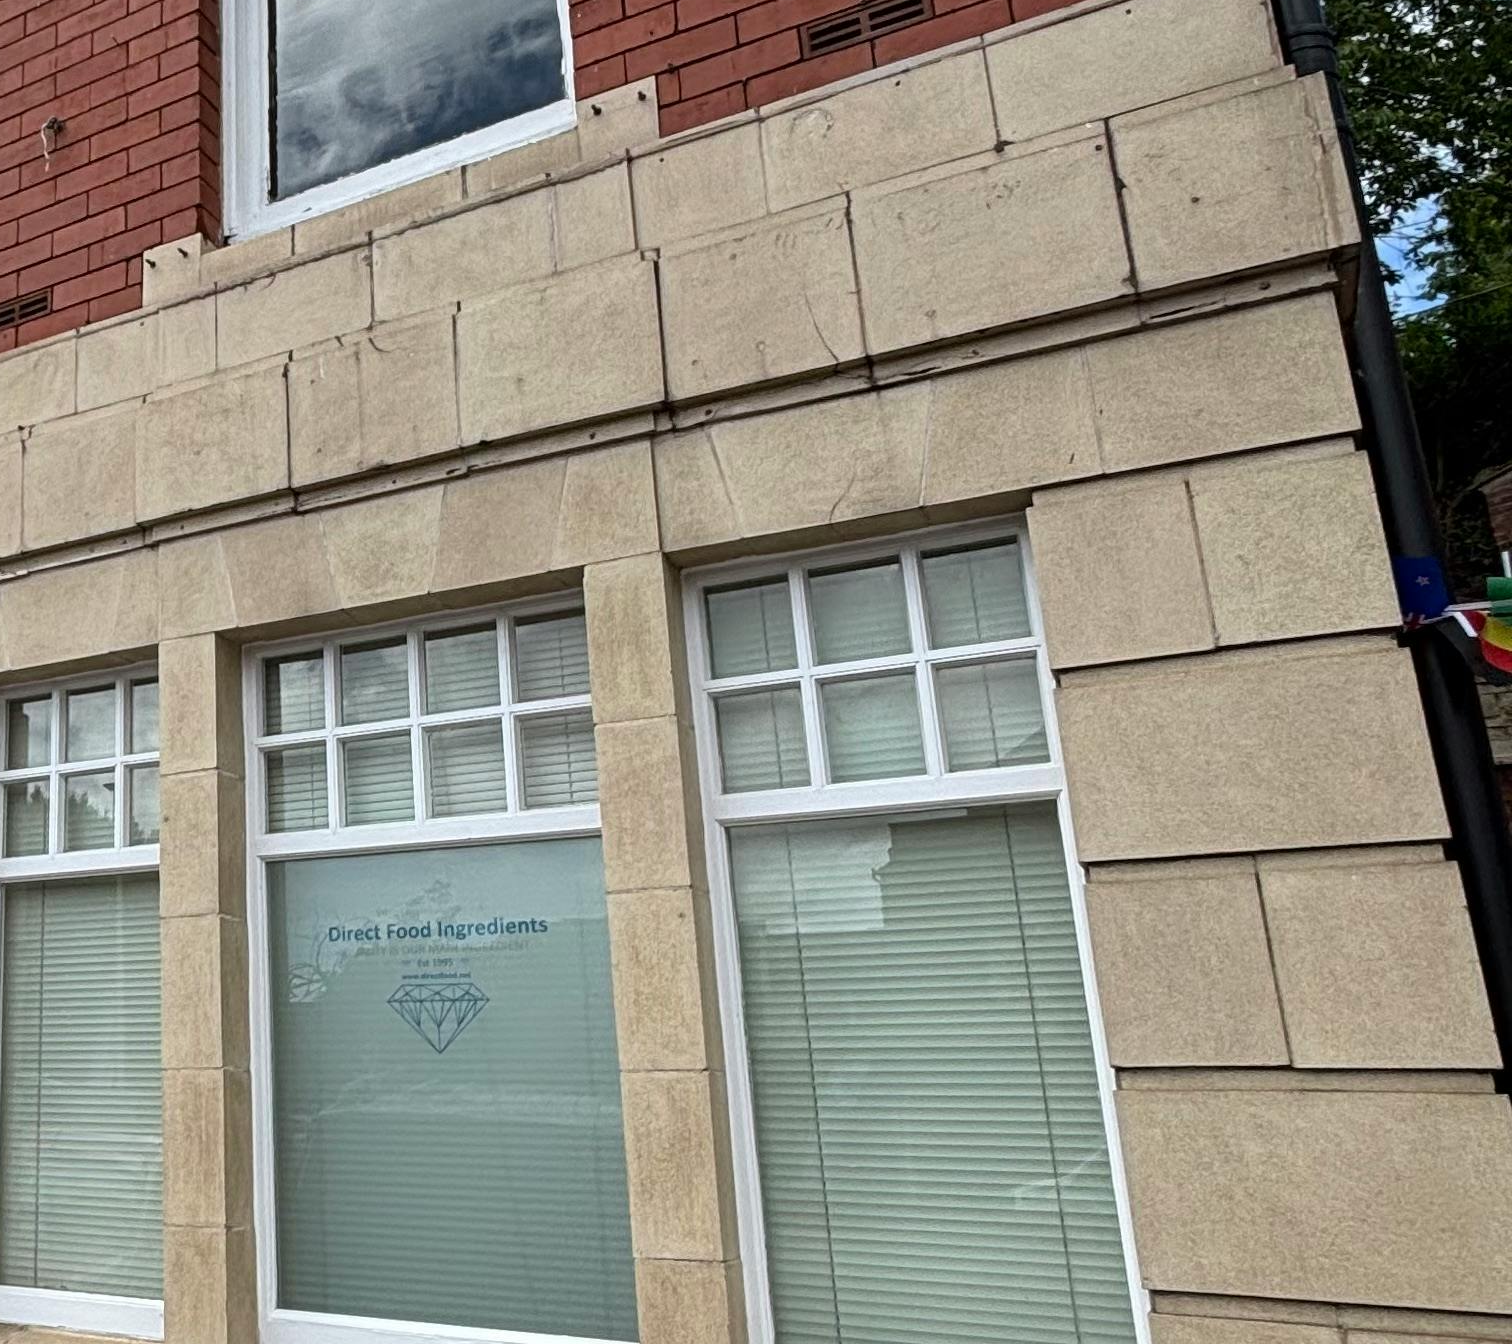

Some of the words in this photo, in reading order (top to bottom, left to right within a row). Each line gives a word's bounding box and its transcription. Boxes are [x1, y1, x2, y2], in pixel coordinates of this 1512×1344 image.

[327, 924, 382, 943] Direct
[387, 920, 432, 940] Food
[437, 916, 549, 942] Ingredients
